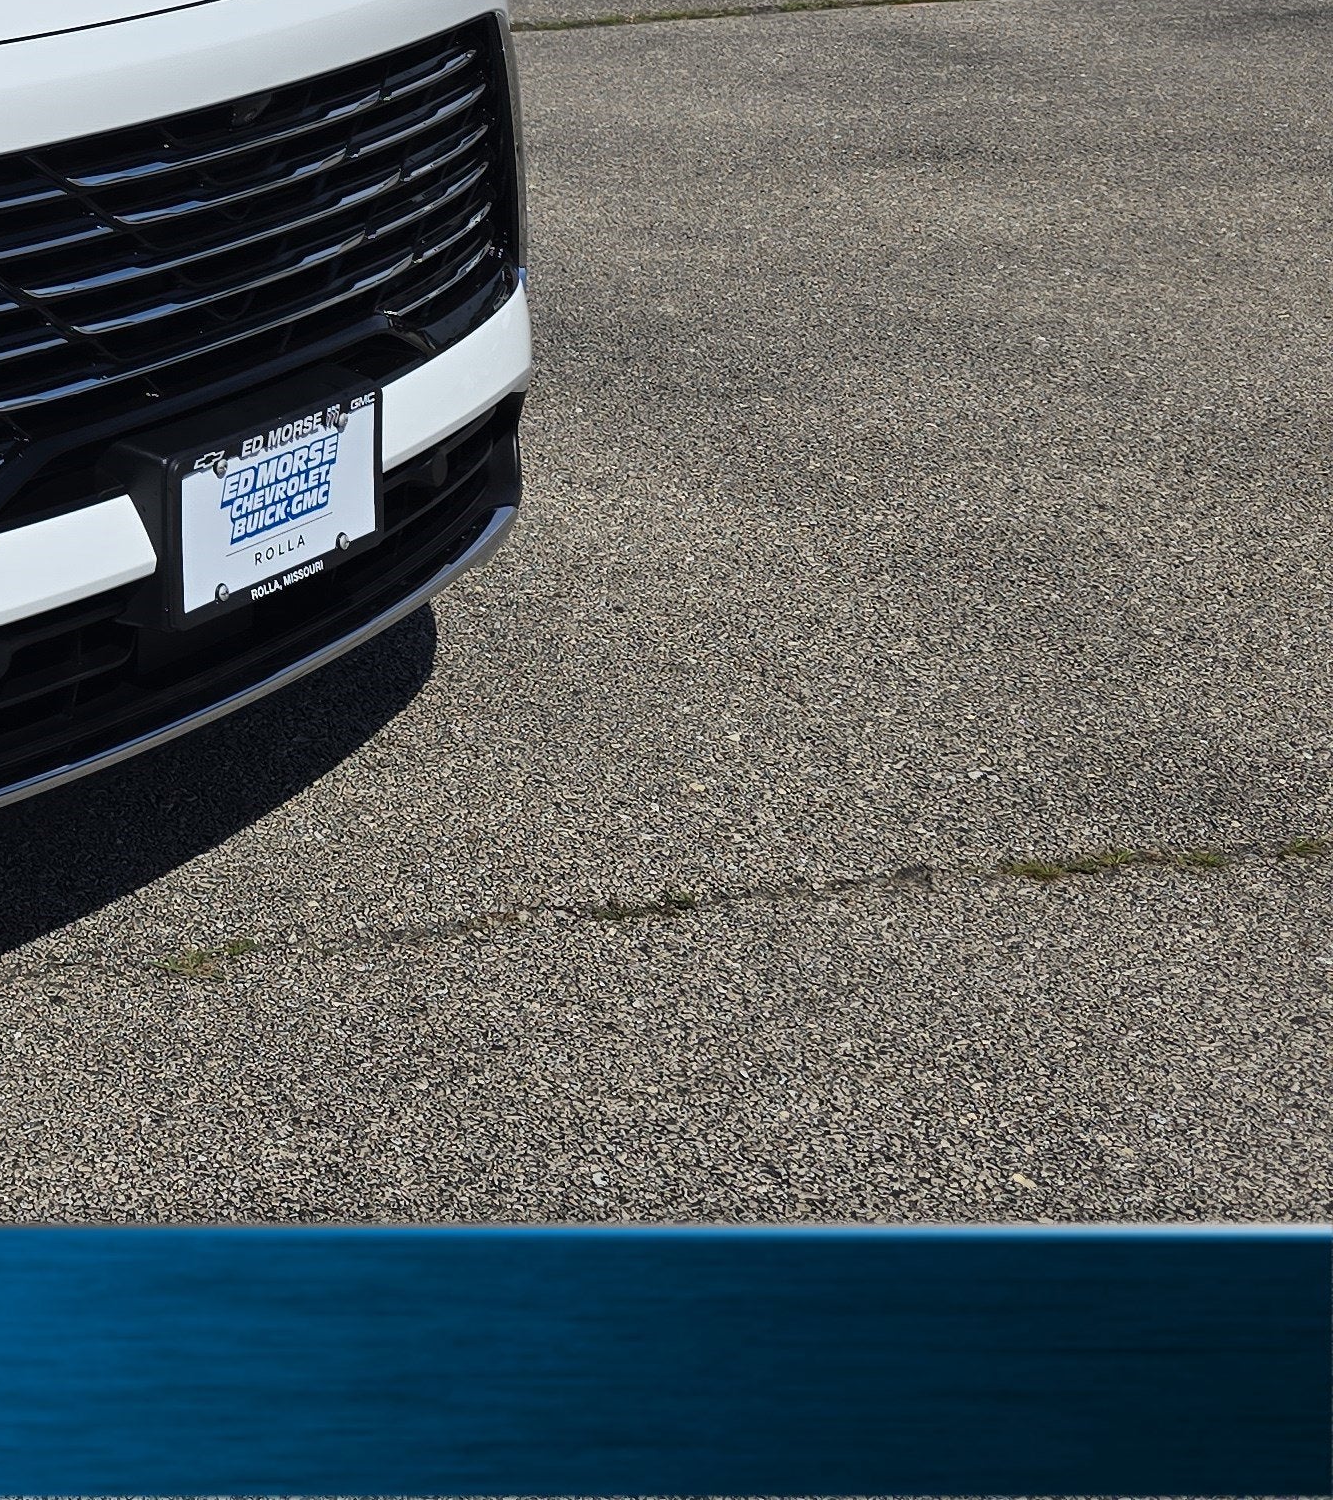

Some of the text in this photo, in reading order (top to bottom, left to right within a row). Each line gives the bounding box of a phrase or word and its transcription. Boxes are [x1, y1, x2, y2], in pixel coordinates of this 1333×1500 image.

[350, 392, 376, 410] GMC
[241, 411, 323, 458] ED MORSE
[222, 435, 338, 503] ED MORSE
[254, 534, 305, 566] ROLLA
[250, 559, 324, 601] ROLLA, MISSOURI
